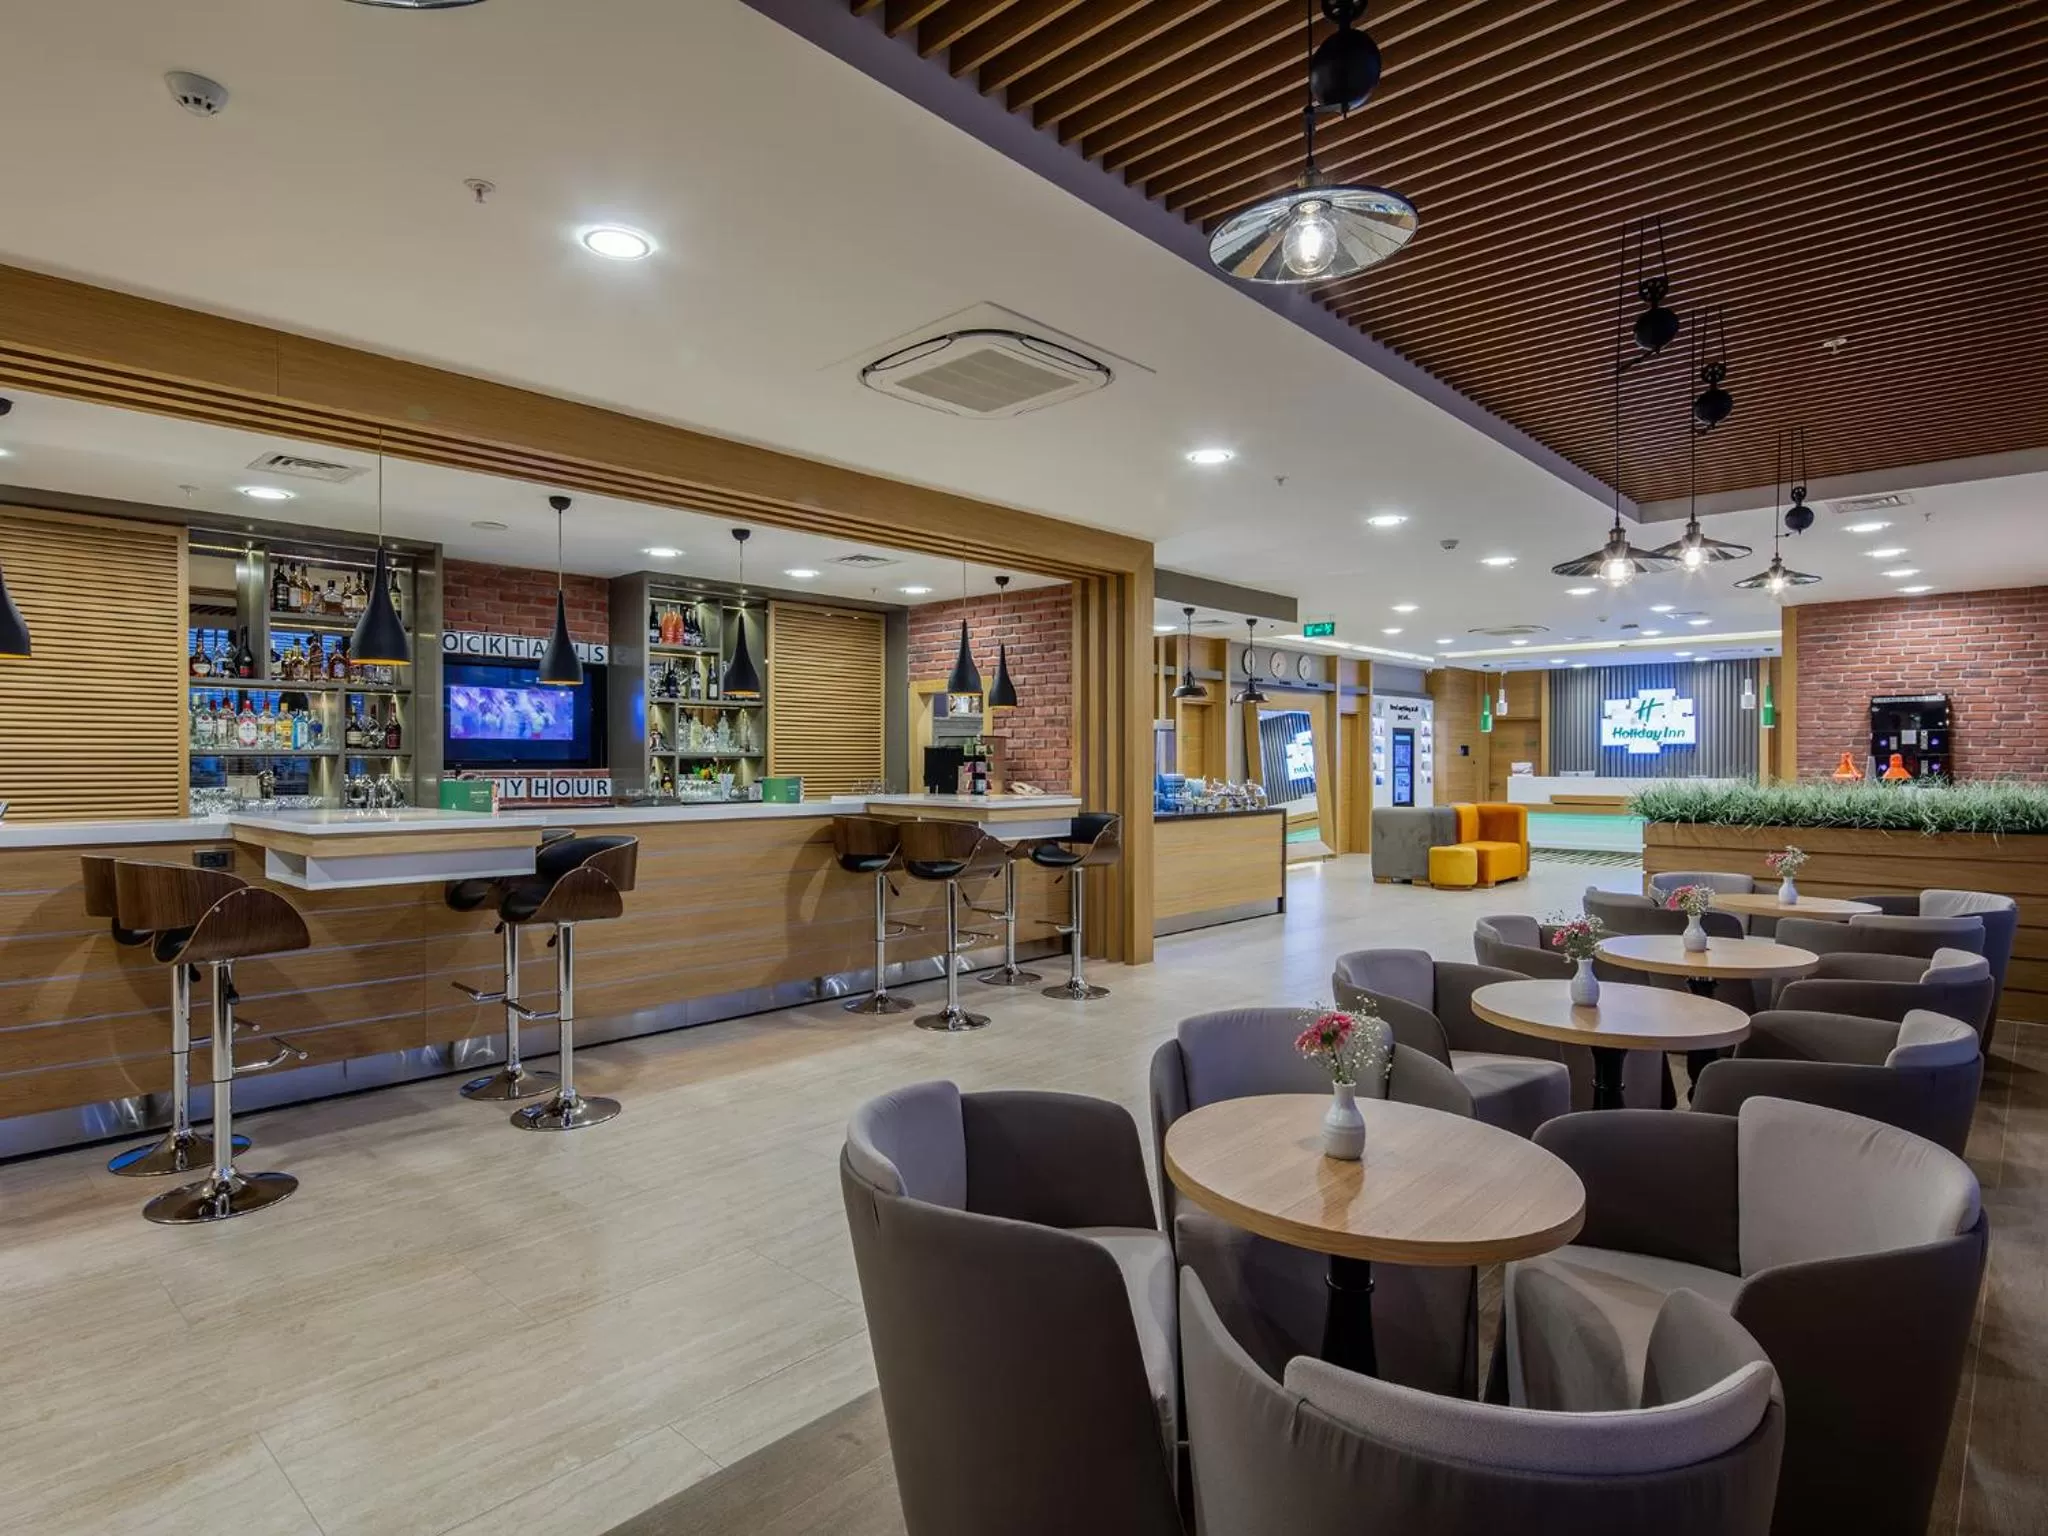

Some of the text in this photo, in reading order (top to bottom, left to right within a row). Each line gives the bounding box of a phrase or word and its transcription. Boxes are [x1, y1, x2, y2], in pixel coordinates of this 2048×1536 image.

[1612, 726, 1686, 741] Holiday Inn
[535, 779, 608, 797] HOUR
